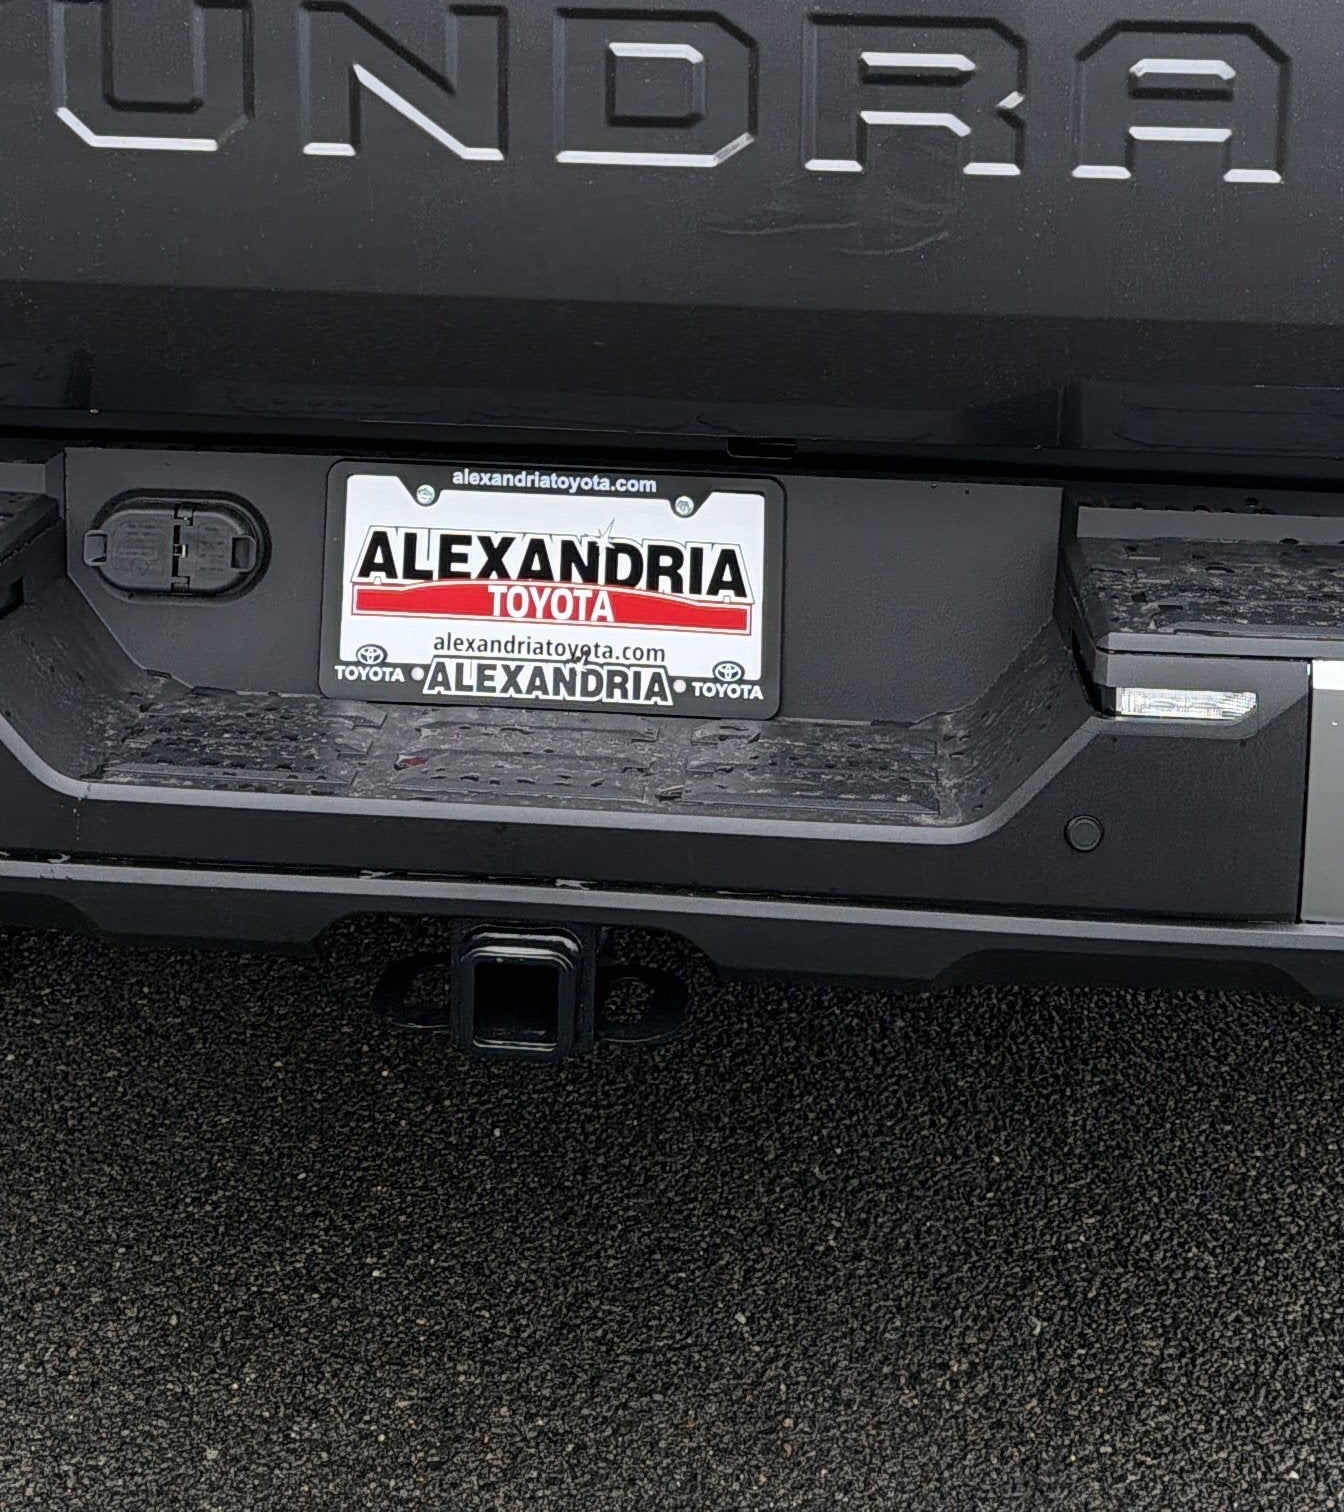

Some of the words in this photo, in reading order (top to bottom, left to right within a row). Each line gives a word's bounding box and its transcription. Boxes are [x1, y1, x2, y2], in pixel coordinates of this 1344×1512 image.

[452, 468, 657, 494] alexandriatoyota.com
[355, 528, 750, 601] ALEXANDRIA
[487, 584, 615, 623] TOYOTA
[433, 632, 666, 663] alexandriatoyota.com
[335, 664, 405, 683] TOYOTA
[423, 657, 674, 705] ALEXANDRIA
[691, 681, 763, 700] TOYOTA
